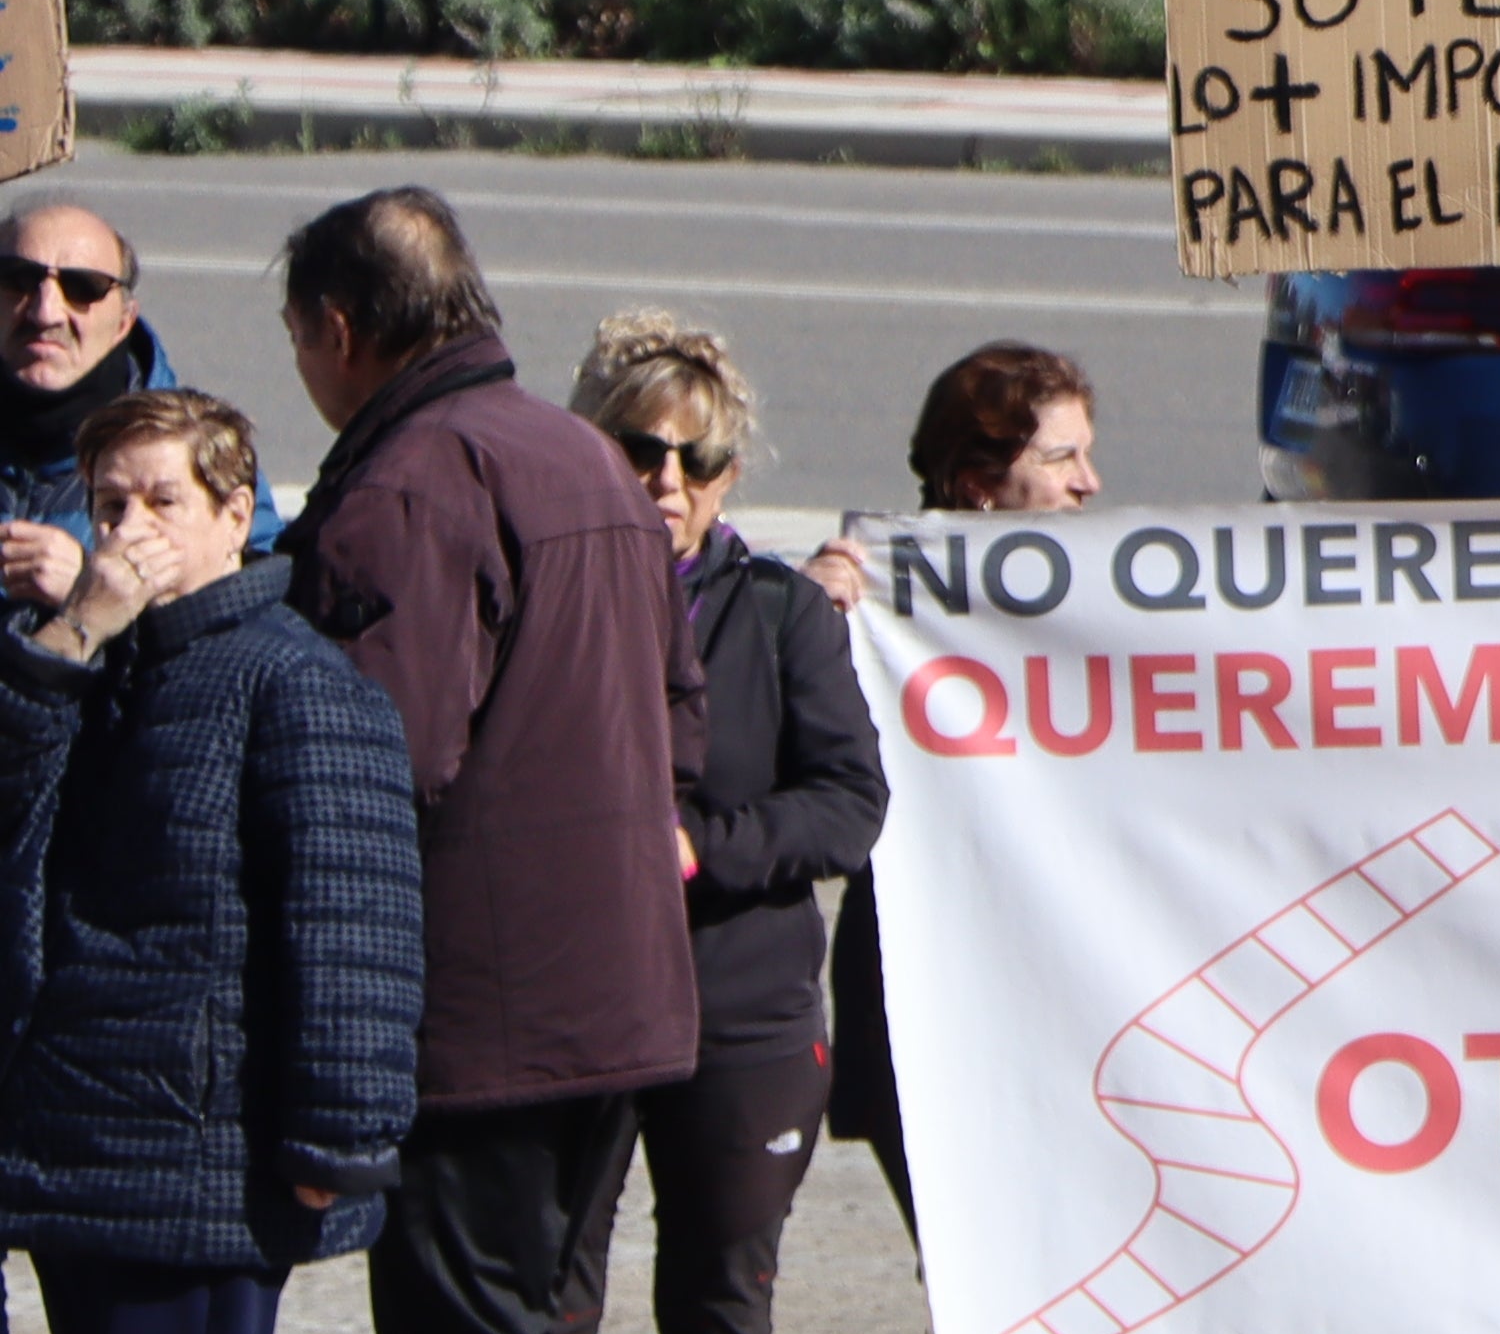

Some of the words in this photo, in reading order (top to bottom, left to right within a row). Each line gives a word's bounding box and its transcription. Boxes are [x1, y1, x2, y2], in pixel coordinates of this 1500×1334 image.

[1182, 156, 1366, 244] PARA
[1390, 156, 1462, 230] EL
[891, 529, 1072, 617] NO
